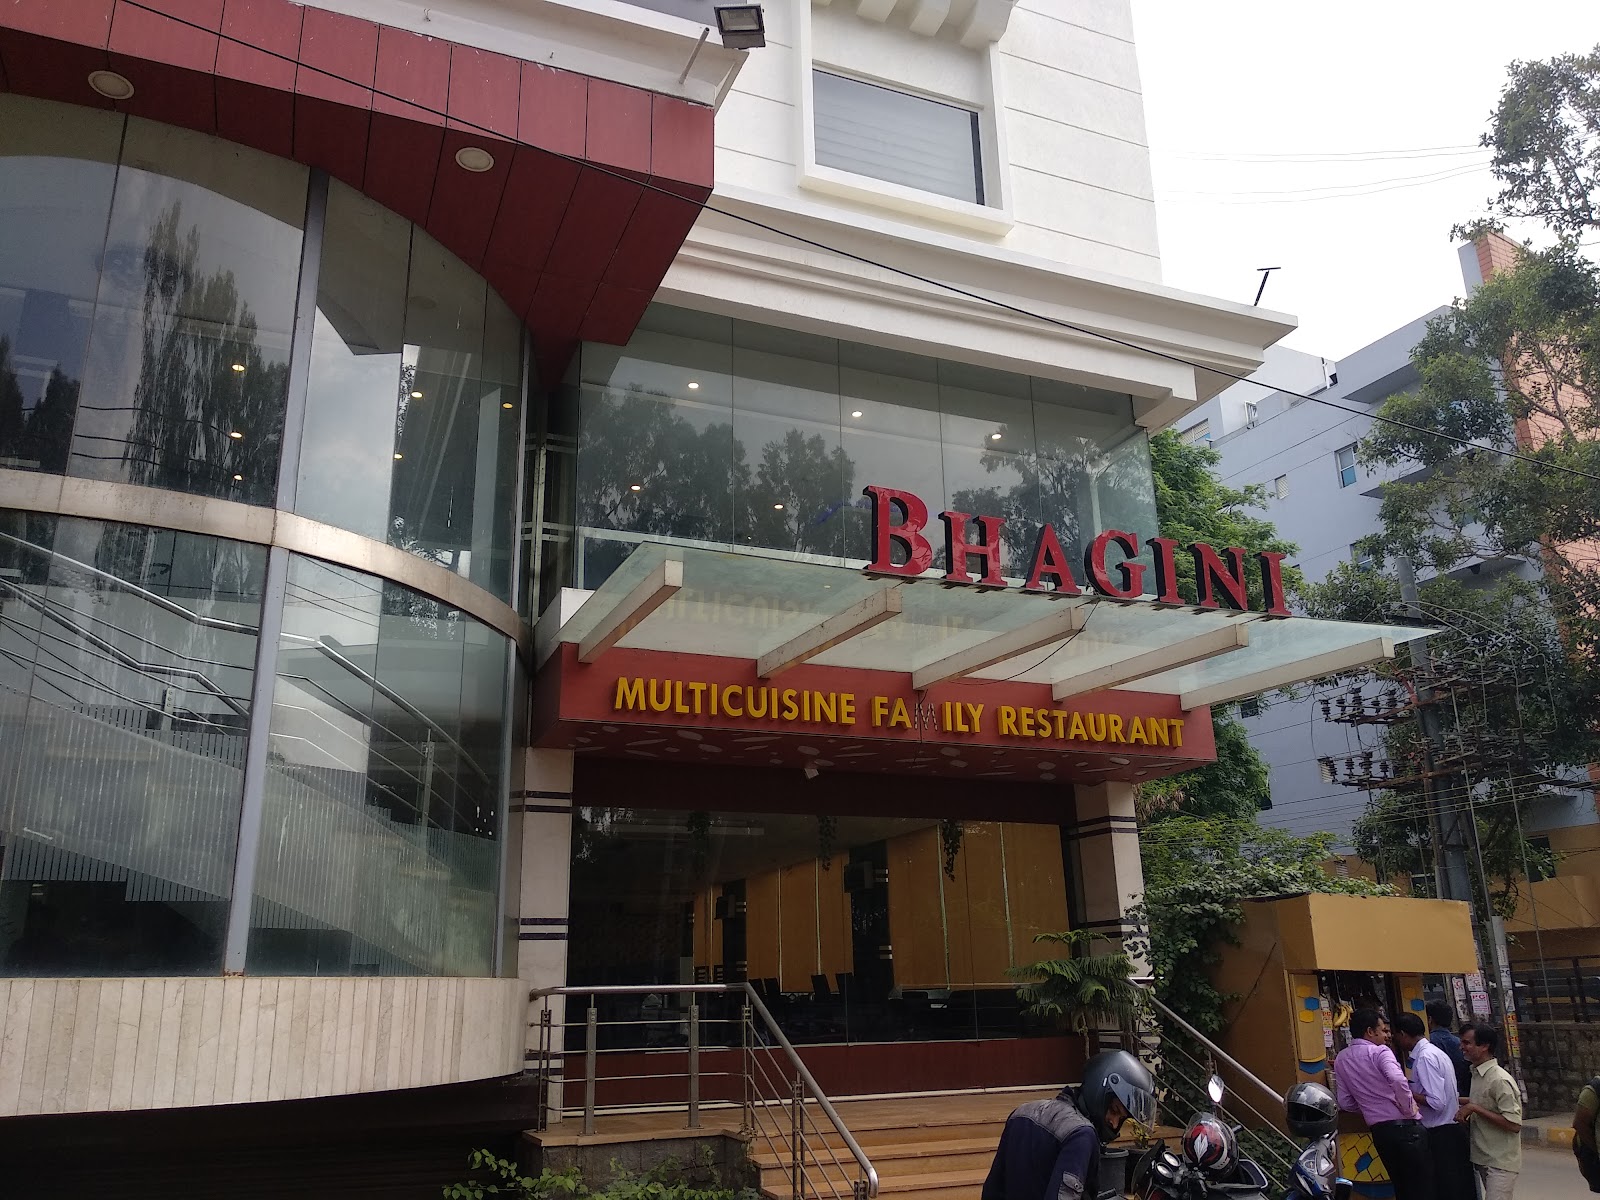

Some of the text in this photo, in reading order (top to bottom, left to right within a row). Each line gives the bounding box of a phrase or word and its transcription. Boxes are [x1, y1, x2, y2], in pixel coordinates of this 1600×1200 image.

[863, 485, 1292, 615] BHAGINI
[615, 676, 856, 724] MULTICUISINE
[998, 706, 1185, 748] RESTAURANT
